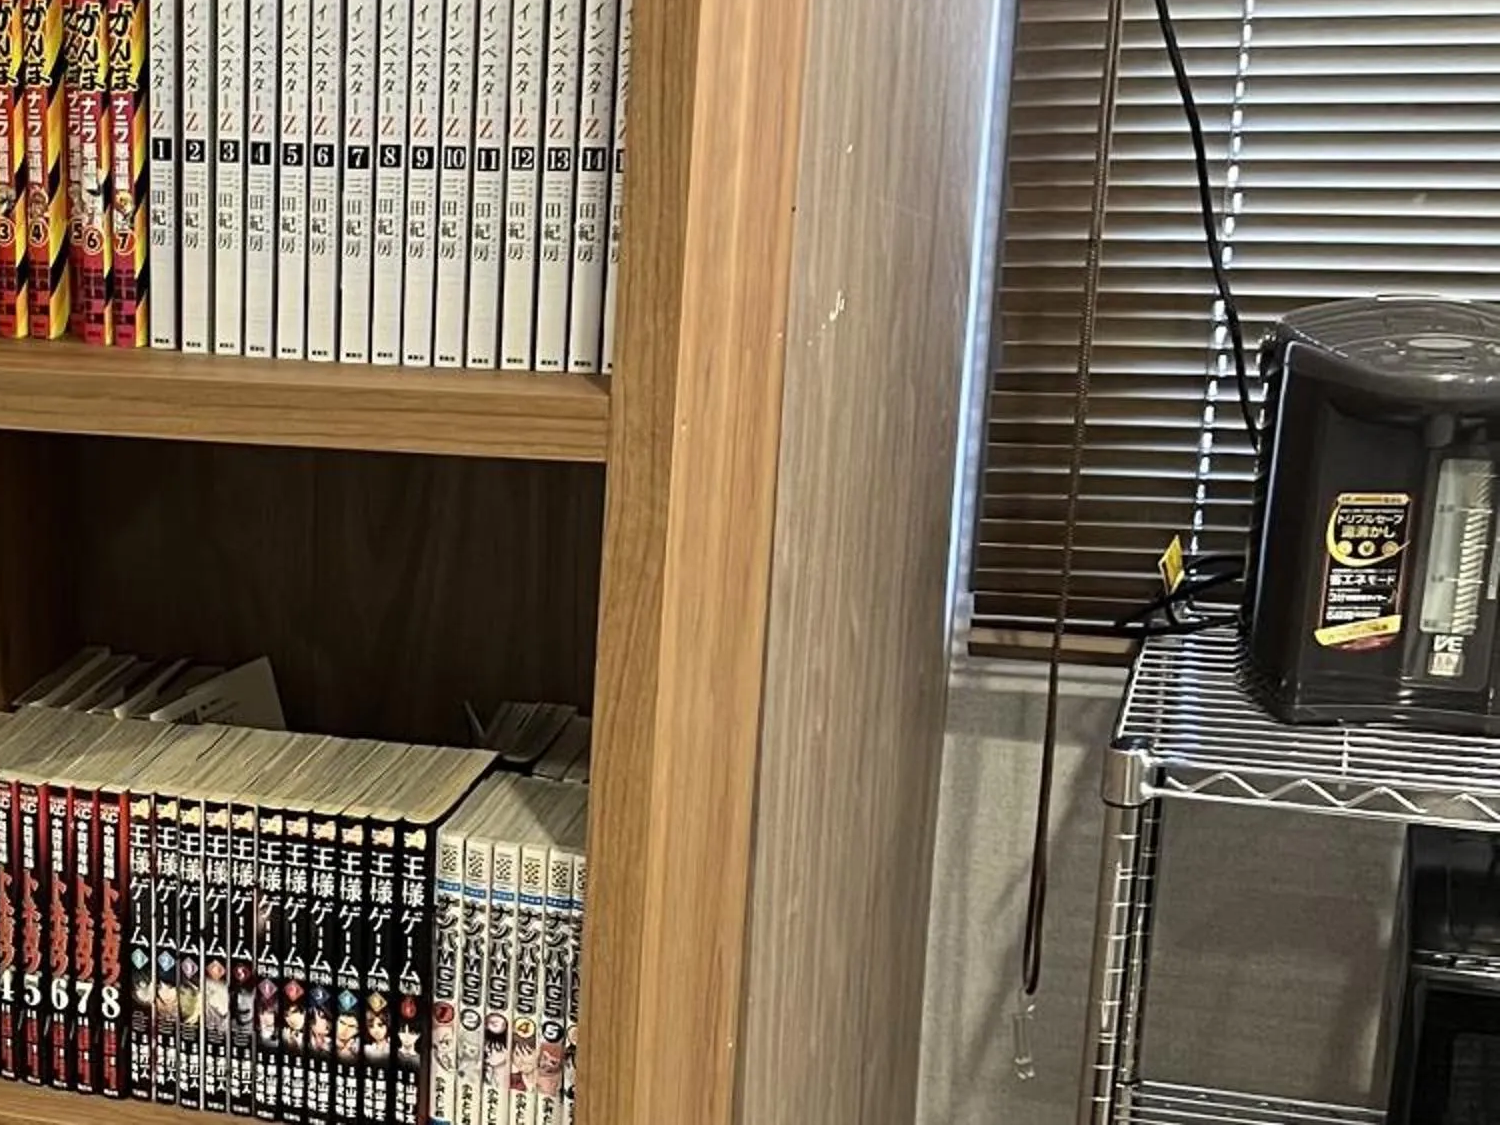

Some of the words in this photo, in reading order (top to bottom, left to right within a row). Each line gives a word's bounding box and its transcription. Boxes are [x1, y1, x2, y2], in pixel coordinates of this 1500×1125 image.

[152, 2, 164, 131] インベスターZ
[186, 2, 199, 131] インベスターZ
[220, 2, 234, 133] インベスターZ
[251, 2, 266, 133] インベスターZ
[284, 3, 298, 135] インベスターZ
[315, 3, 330, 135] インベスターZ
[349, 3, 363, 137] インベスターZ
[381, 3, 396, 135] インベスターZ
[414, 3, 429, 137] インベスターZ
[447, 3, 462, 137] インベスターZ
[479, 3, 497, 139] インベスターZ
[514, 3, 531, 139] インベスターZ
[549, 3, 568, 139] インベスターZ
[584, 3, 604, 139] インベスターZ
[130, 826, 149, 947] 王様ゲーム
[157, 829, 176, 949] 王様ゲーム
[180, 833, 199, 955] 王様ゲーム
[206, 836, 226, 956] 王様ゲーム
[231, 838, 253, 959] 王様ゲーム
[258, 843, 279, 965] 王様ゲーム
[285, 845, 306, 967] 王様ゲーム
[310, 848, 333, 975] 王様ゲーム
[339, 852, 360, 977] 王様ゲーム
[369, 853, 392, 980] 王様ゲーム
[400, 856, 424, 984] 王様ゲーム
[0, 969, 14, 1001] 4
[24, 974, 41, 1006] 5
[51, 981, 69, 1010] 6
[75, 982, 94, 1014] 7
[102, 986, 120, 1018] 8
